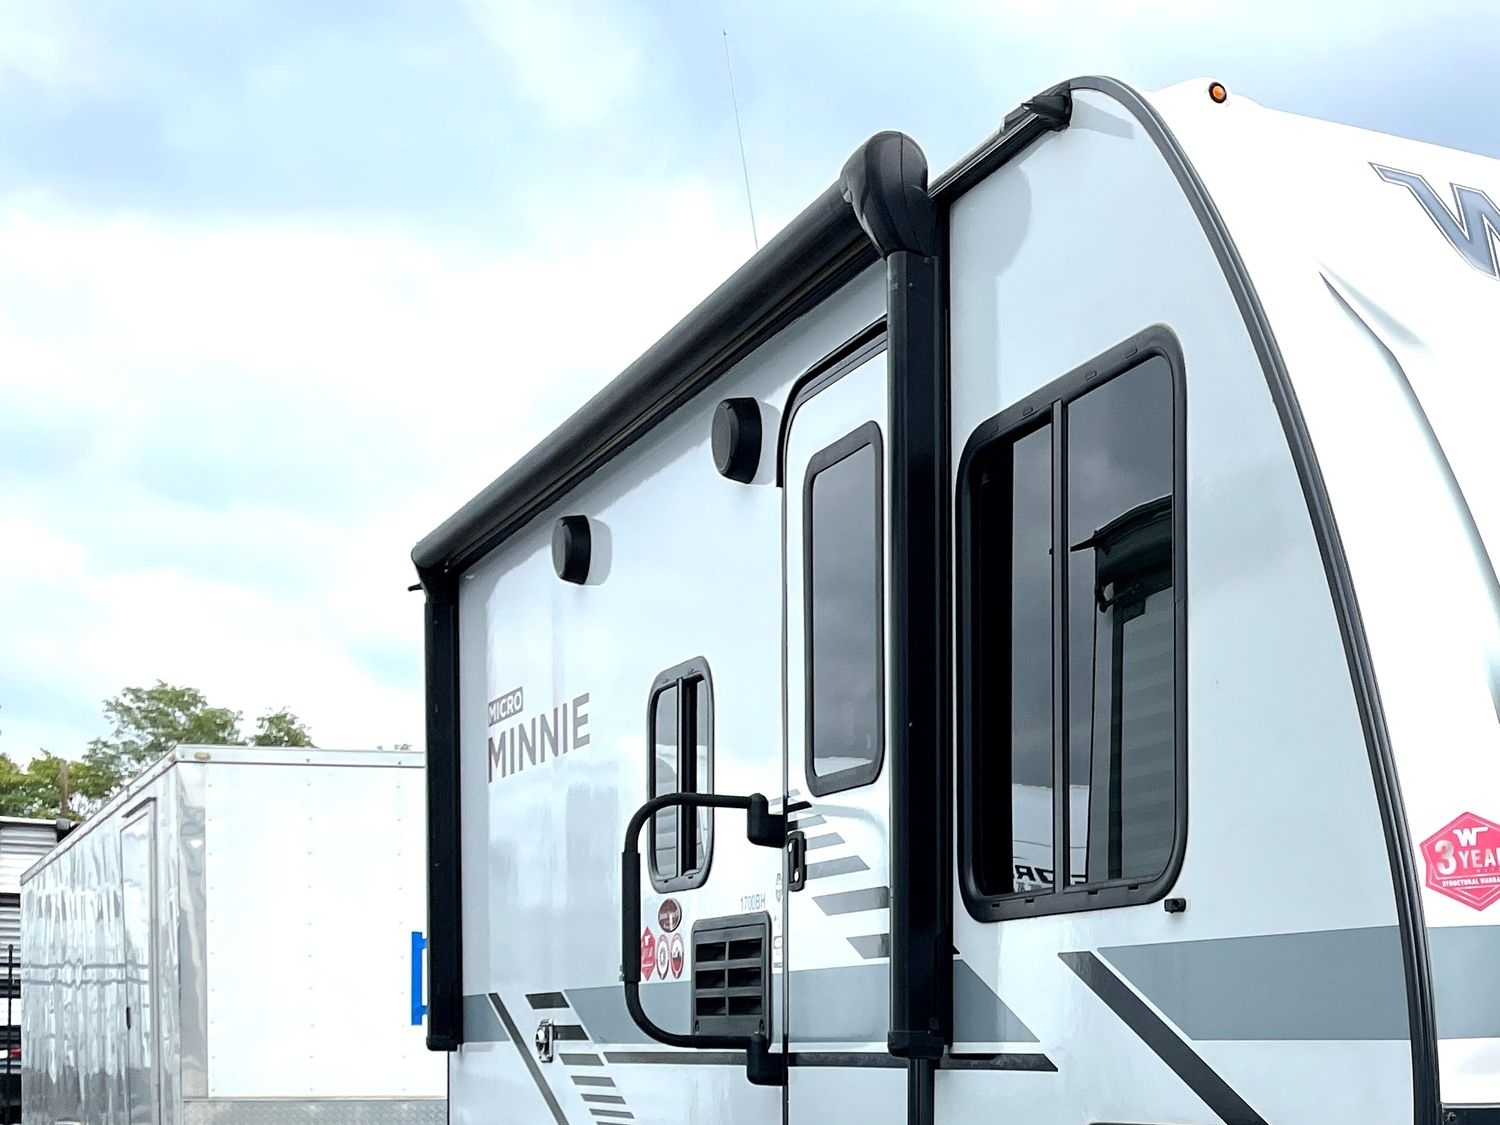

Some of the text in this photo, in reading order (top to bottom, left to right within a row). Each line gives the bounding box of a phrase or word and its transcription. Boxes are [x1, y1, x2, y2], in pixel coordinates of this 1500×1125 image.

[488, 690, 522, 725] MICRO
[488, 692, 590, 783] MINNIE
[1434, 840, 1457, 875] 3
